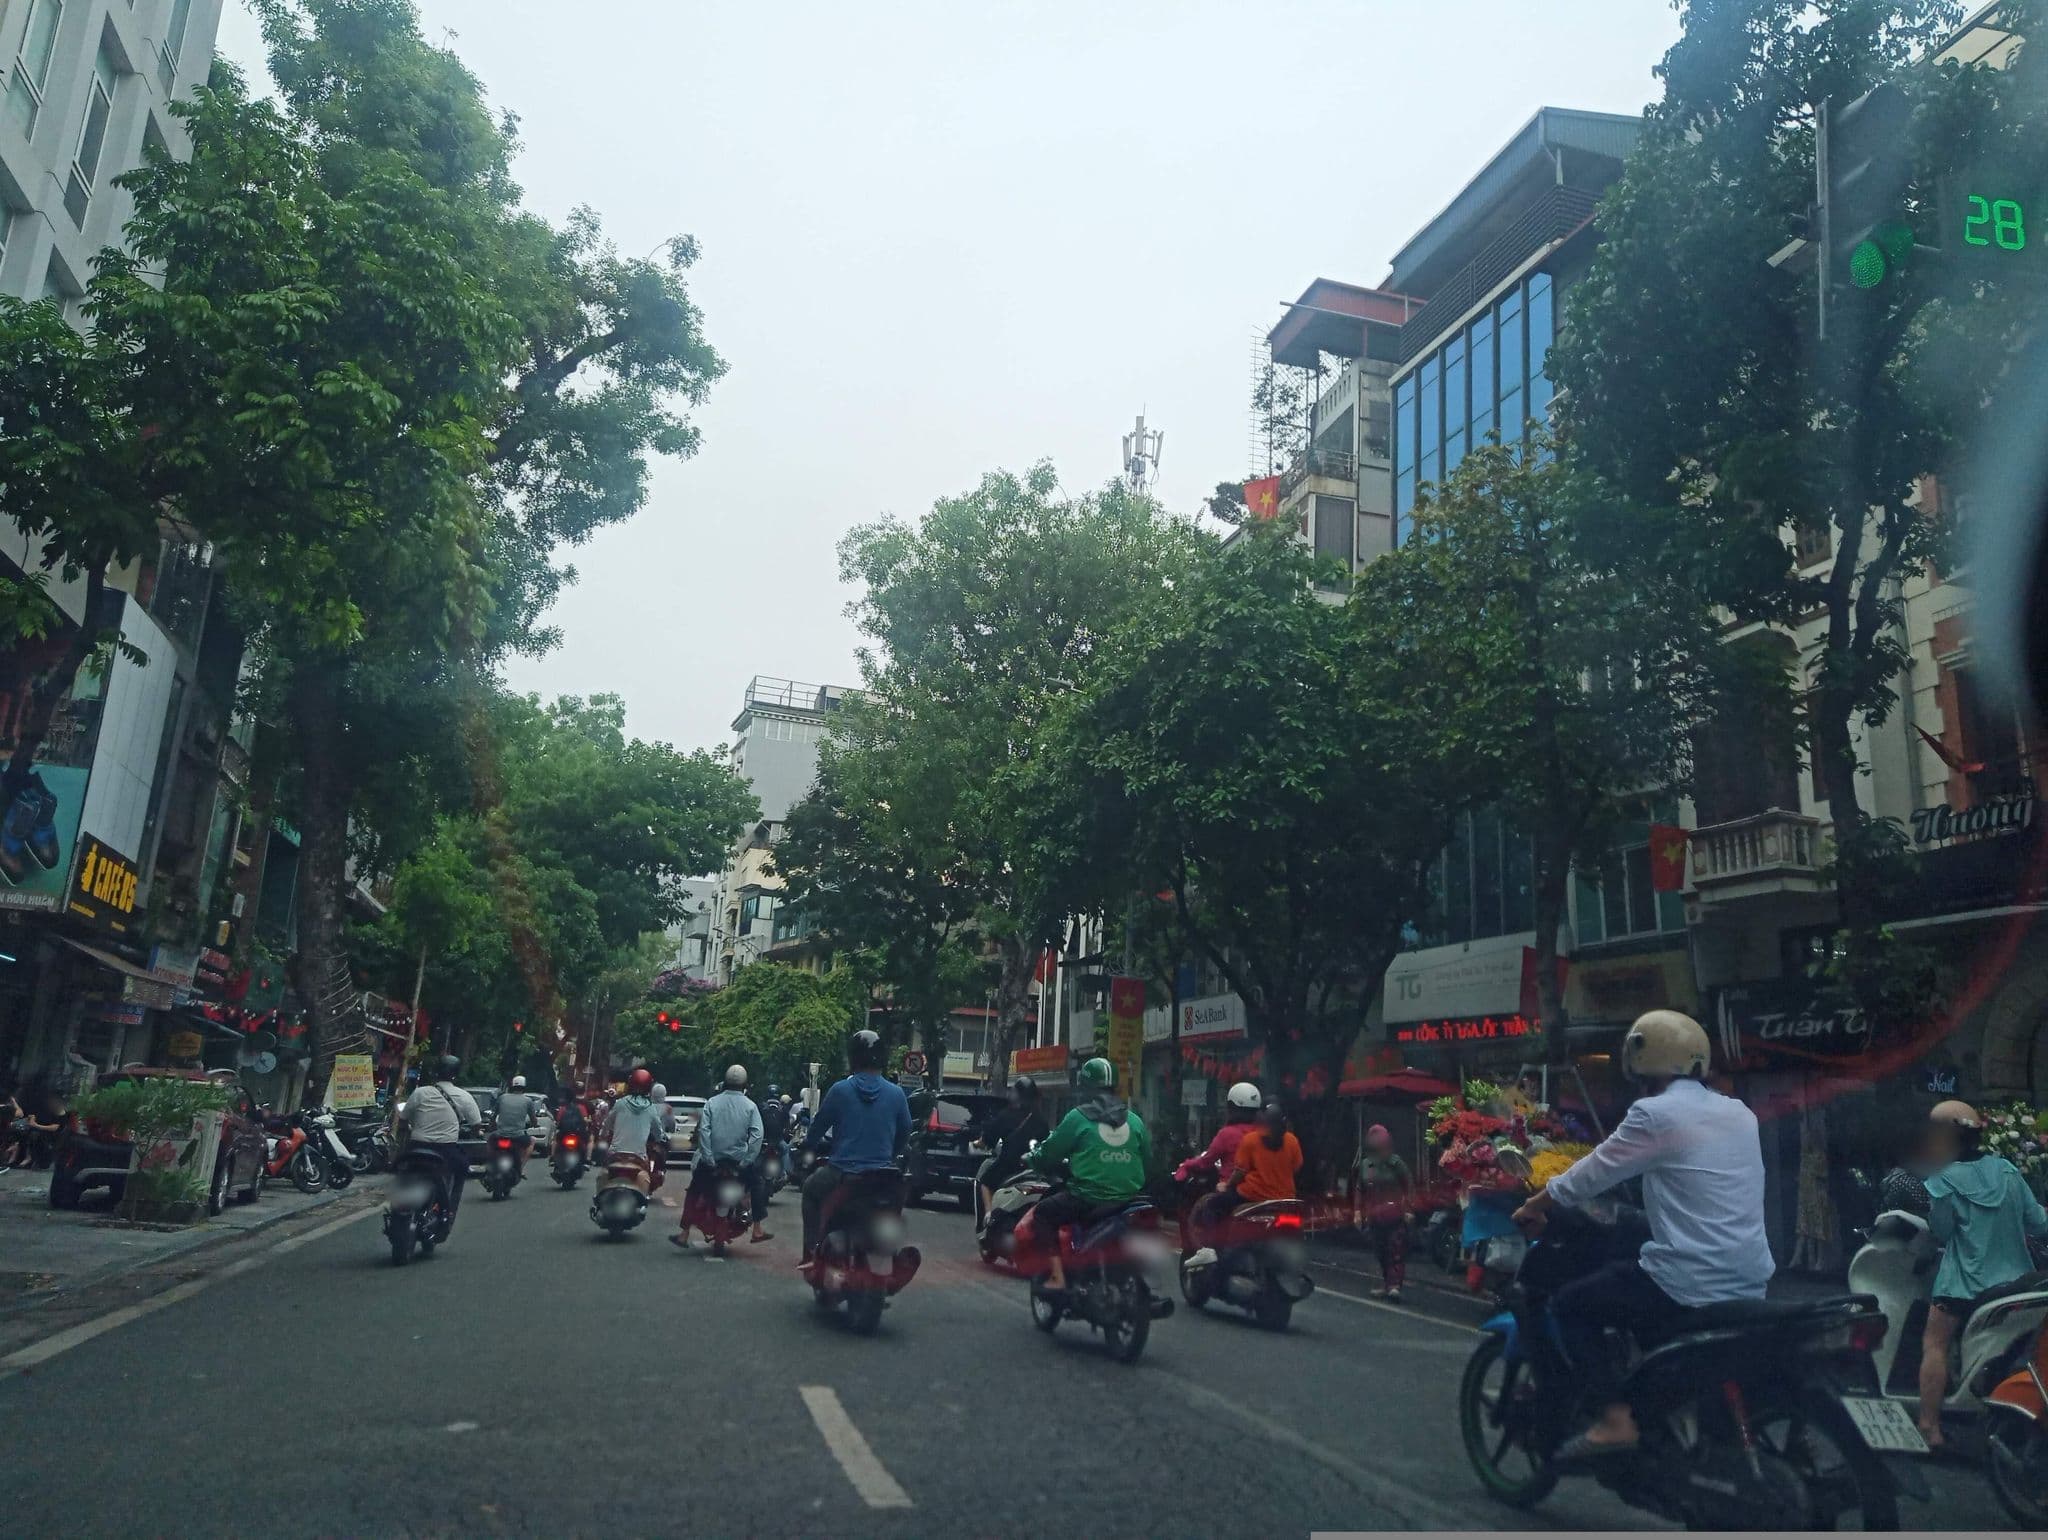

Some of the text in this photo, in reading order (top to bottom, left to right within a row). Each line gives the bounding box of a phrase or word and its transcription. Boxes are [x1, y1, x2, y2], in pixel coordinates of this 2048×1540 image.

[1964, 194, 2027, 251] 28
[1194, 1004, 1228, 1025] SeABank
[1100, 1149, 1132, 1163] Grab
